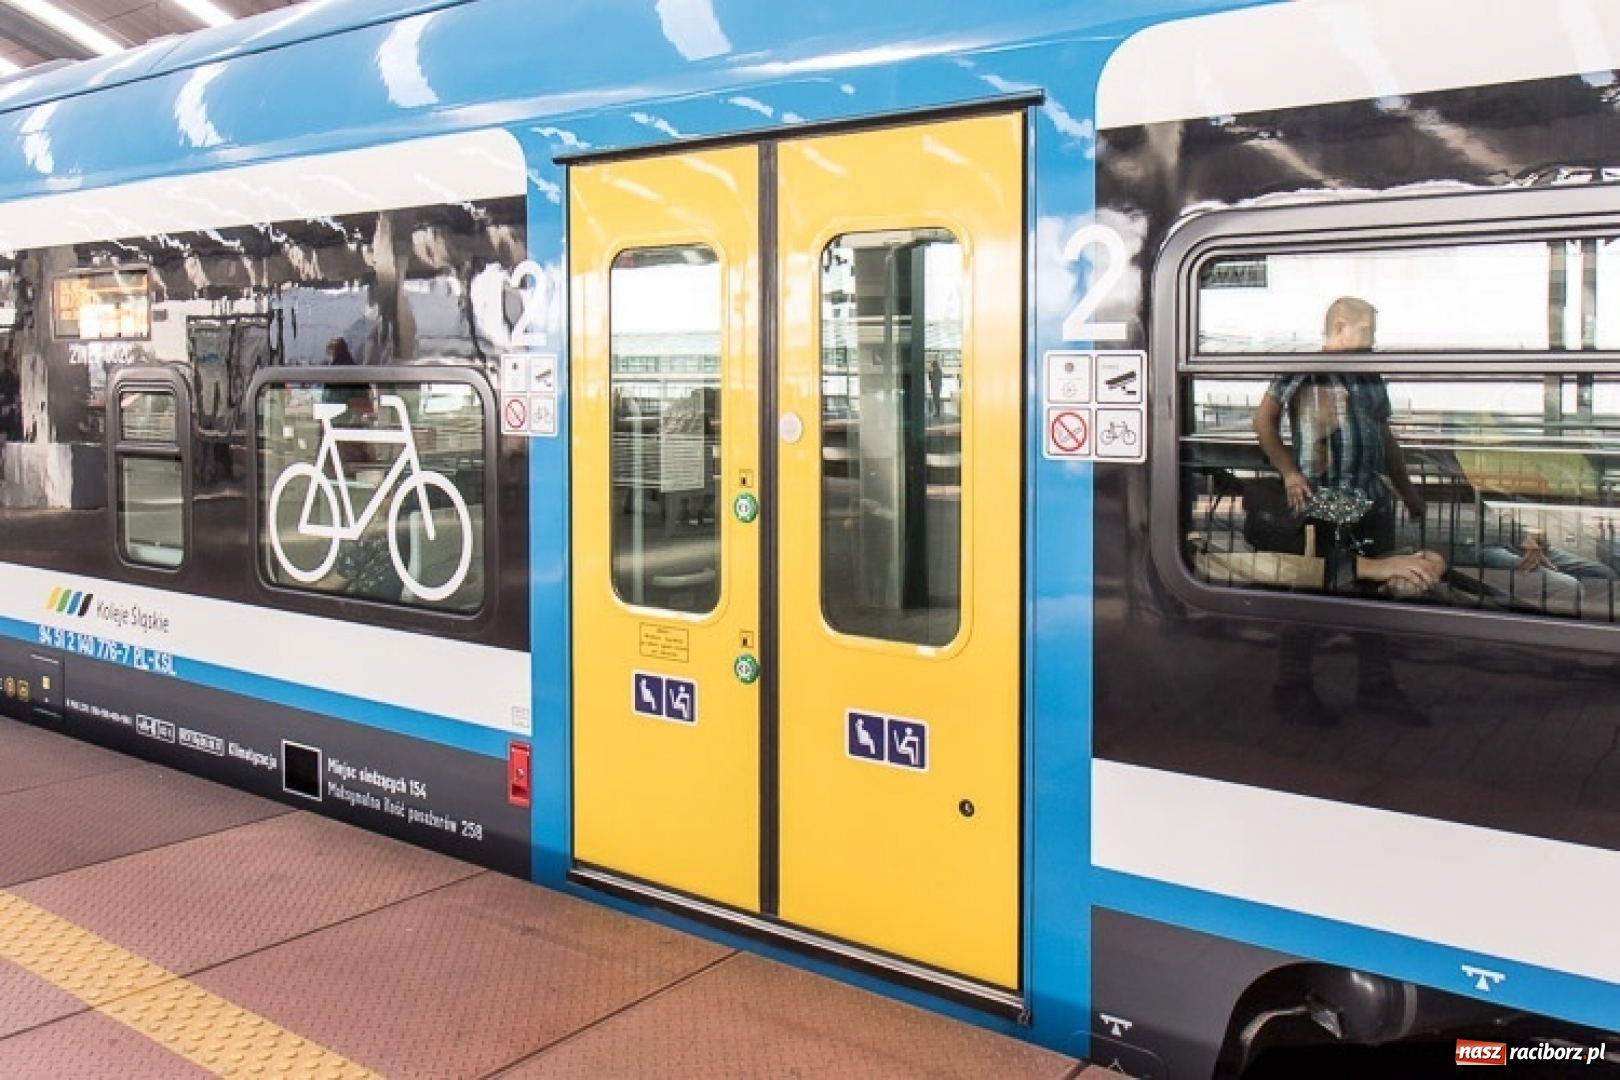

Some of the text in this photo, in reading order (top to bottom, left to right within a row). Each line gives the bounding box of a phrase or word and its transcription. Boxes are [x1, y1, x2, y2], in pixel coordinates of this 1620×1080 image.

[512, 261, 547, 346] 2
[1062, 224, 1128, 340] 2
[97, 601, 129, 627] Koleje
[68, 632, 77, 651] 2
[327, 757, 357, 781] Miejsc
[409, 780, 427, 800] 154
[327, 781, 381, 811] Maksymalna
[461, 820, 483, 841] 258
